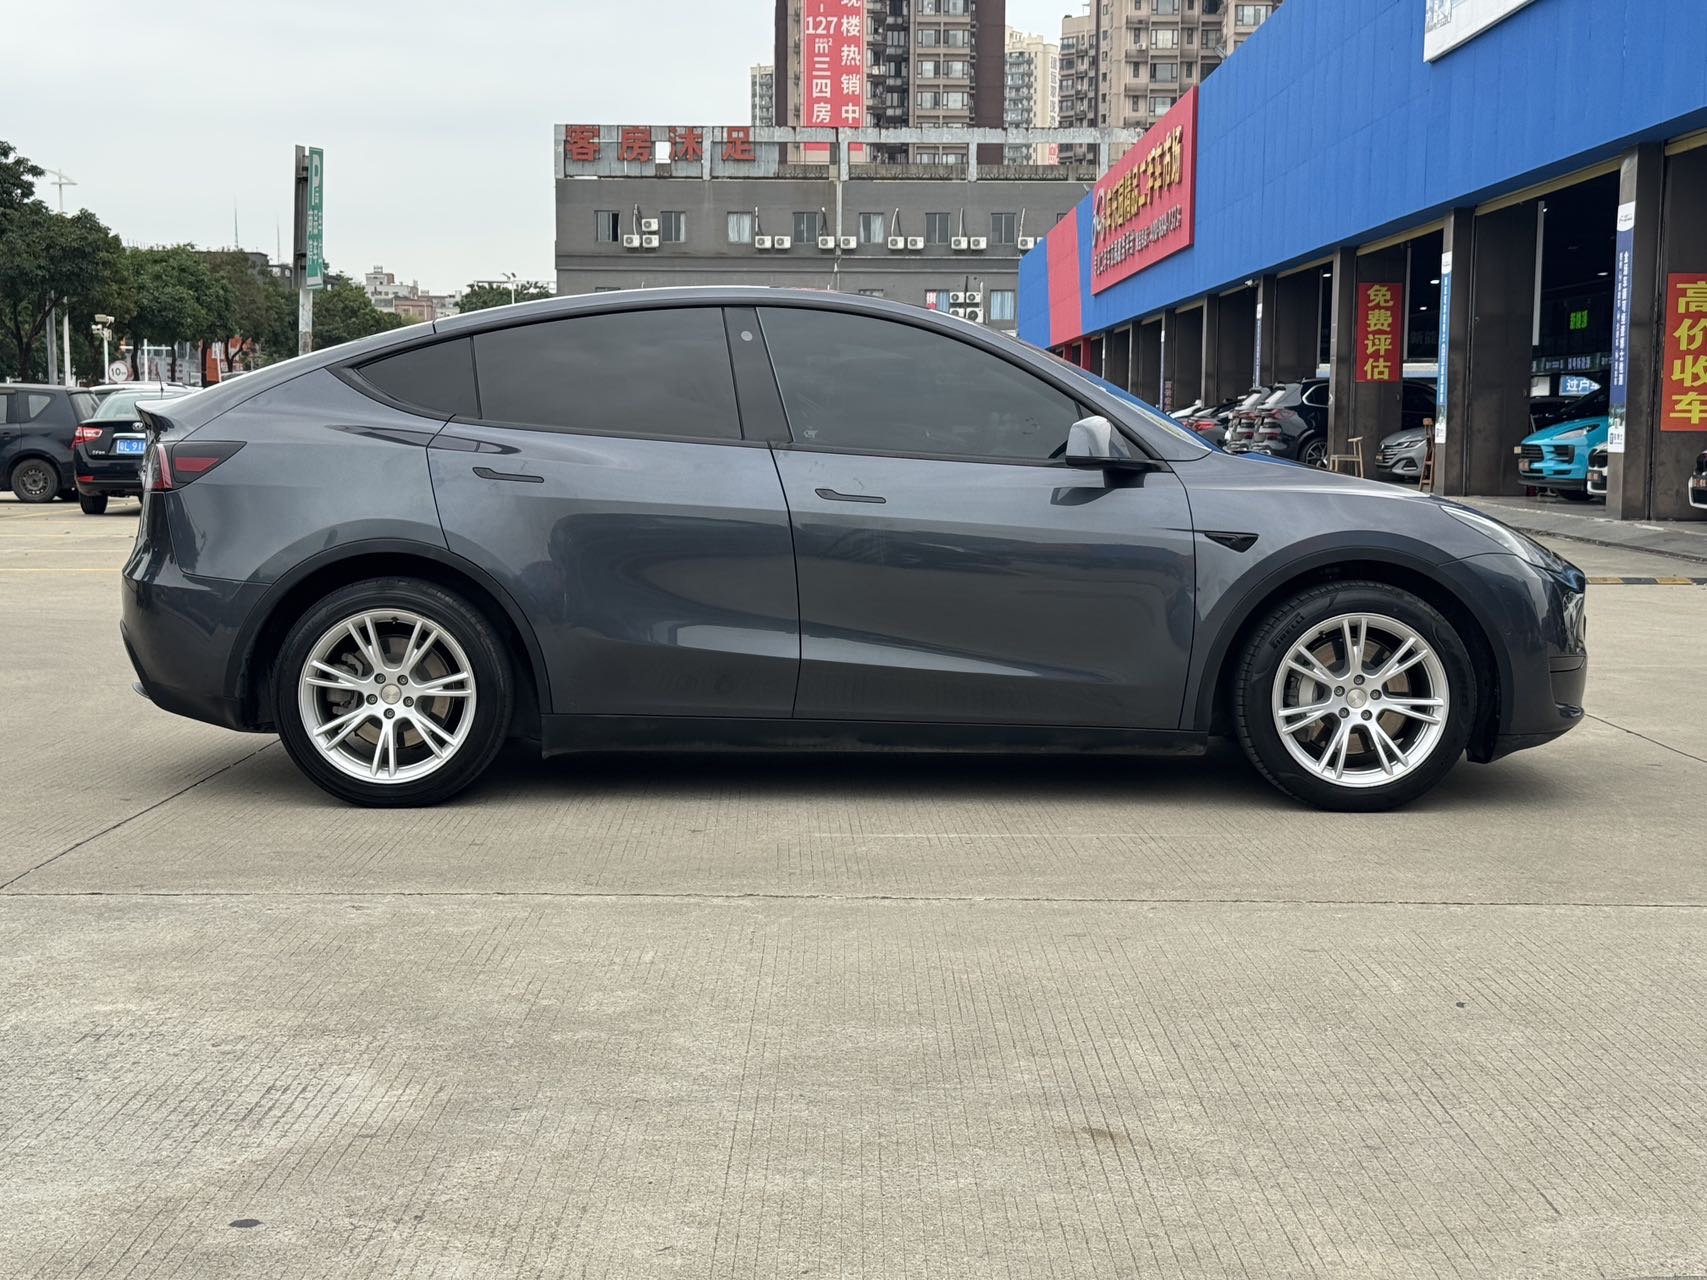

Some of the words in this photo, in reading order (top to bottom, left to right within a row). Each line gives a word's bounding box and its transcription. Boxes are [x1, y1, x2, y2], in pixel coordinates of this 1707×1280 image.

[565, 125, 756, 161] 客房沐足
[1364, 284, 1394, 380] 免费评估
[1669, 281, 1707, 424] 高价收车
